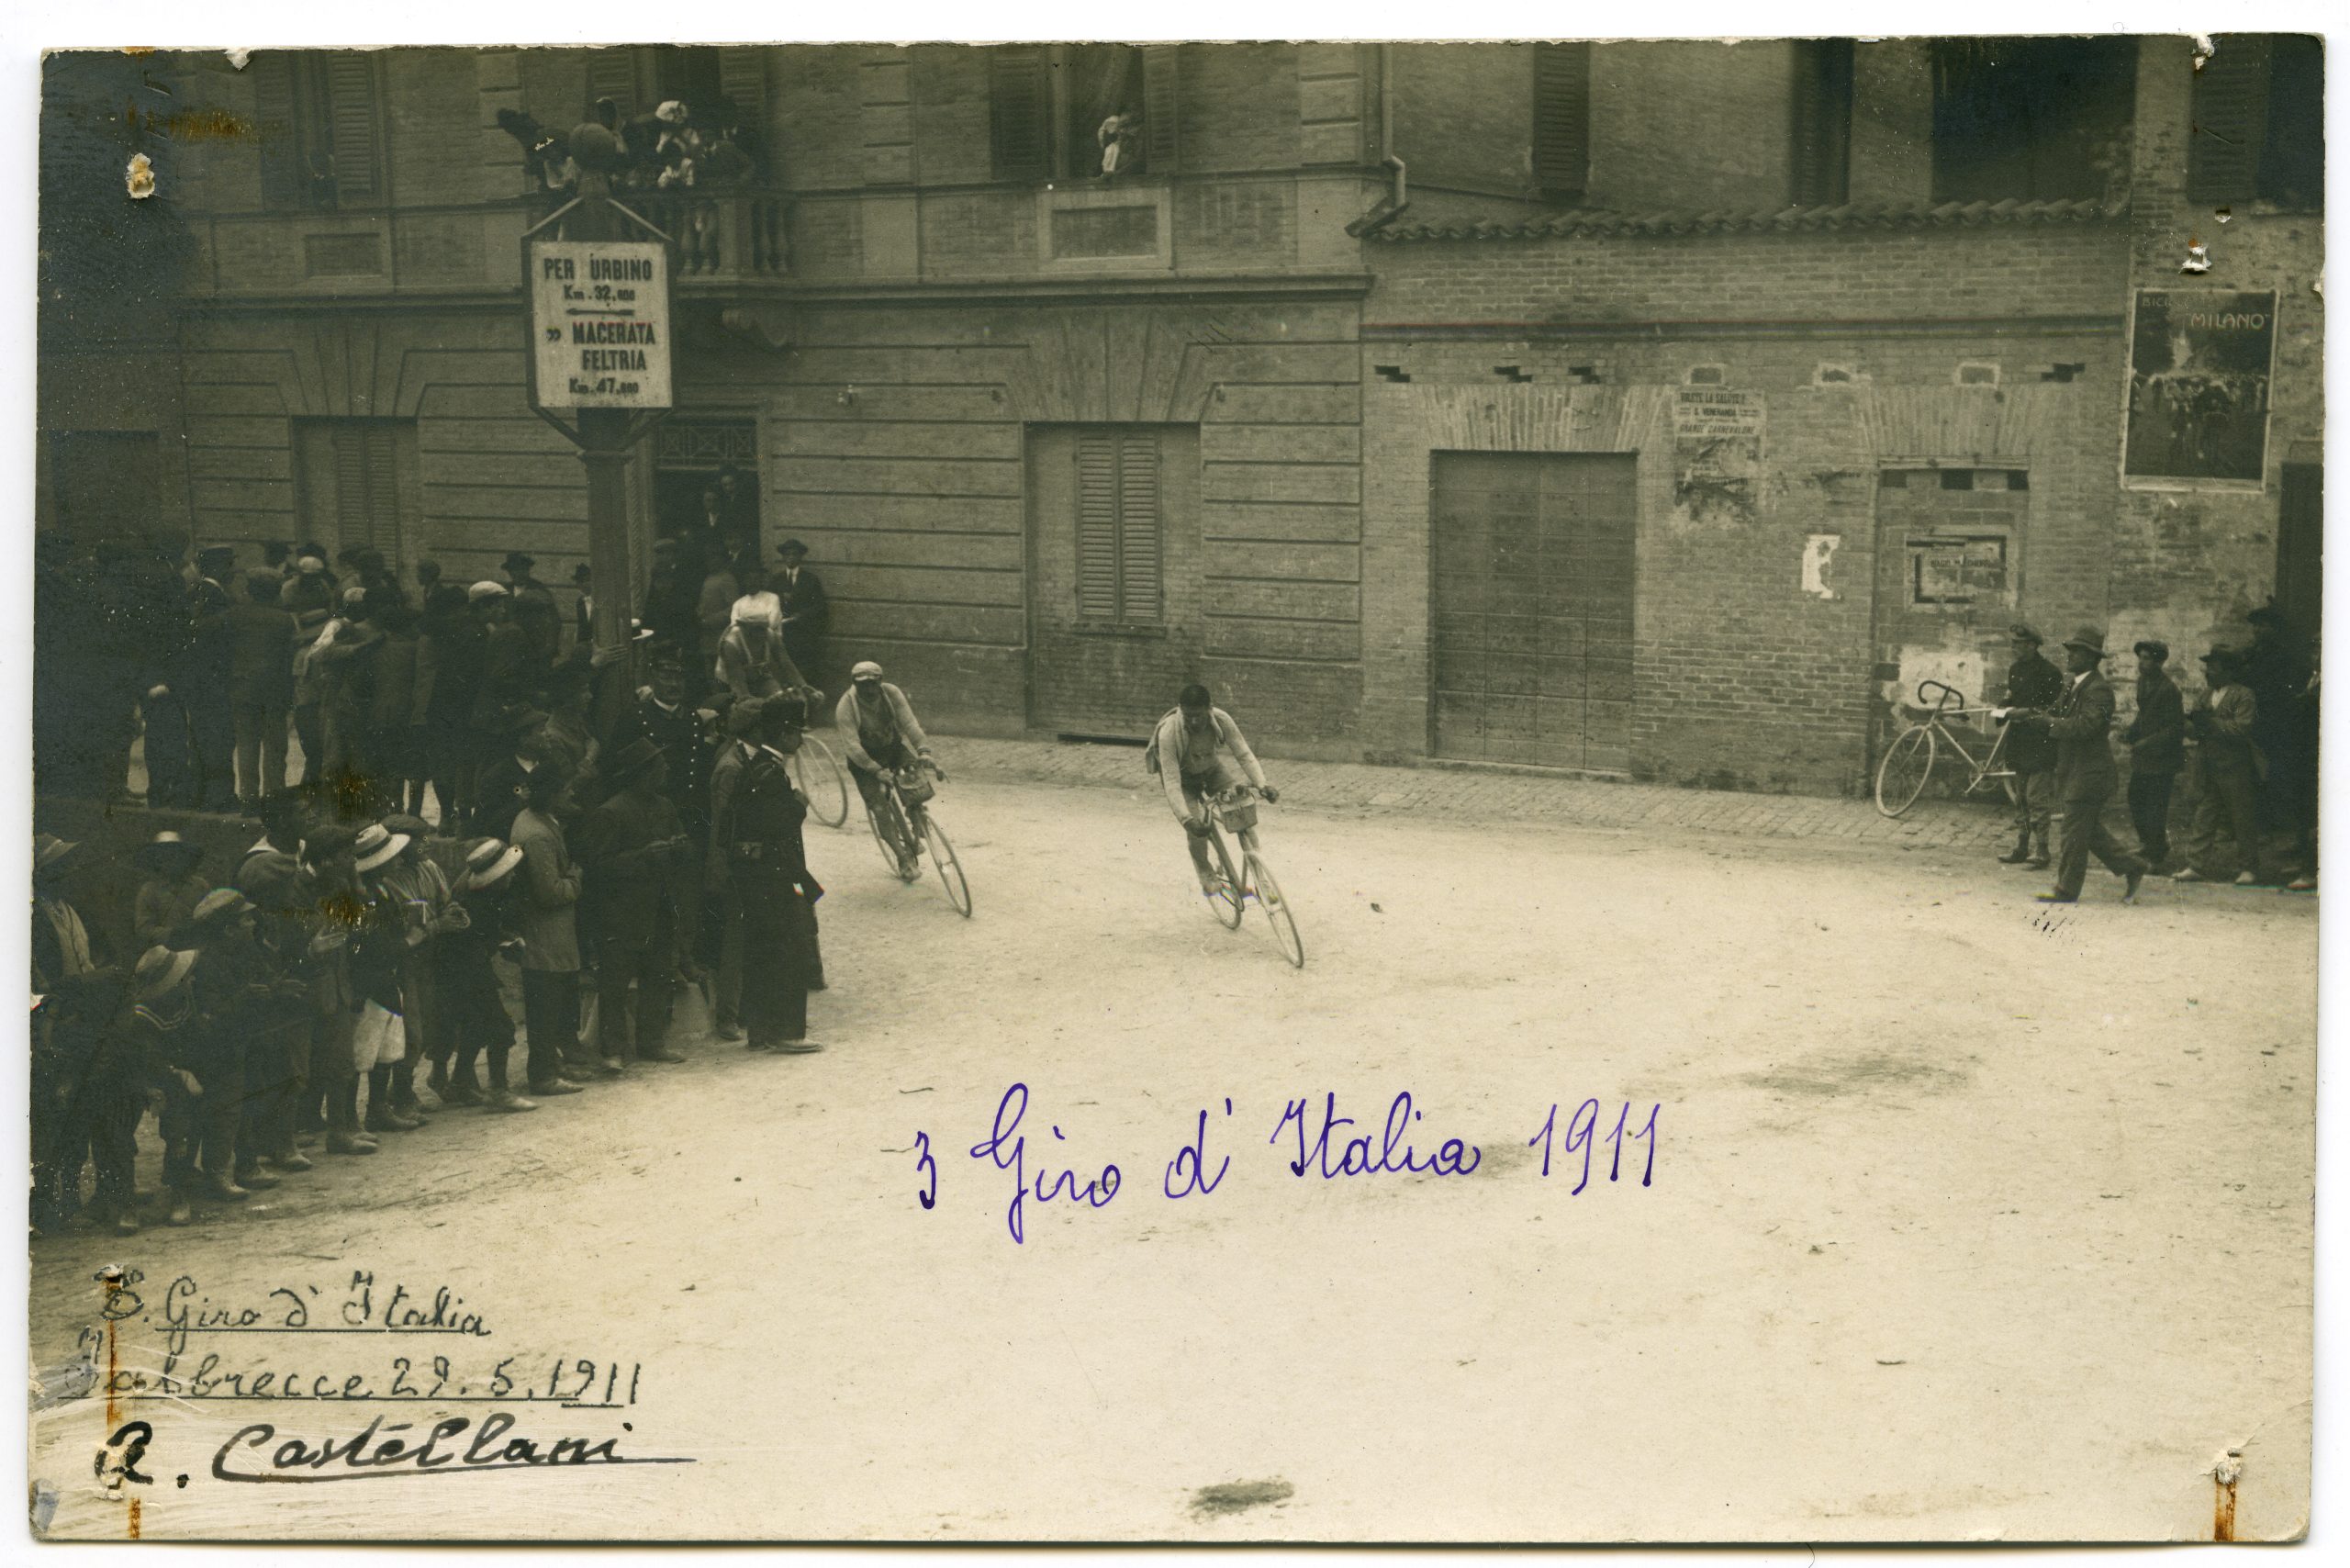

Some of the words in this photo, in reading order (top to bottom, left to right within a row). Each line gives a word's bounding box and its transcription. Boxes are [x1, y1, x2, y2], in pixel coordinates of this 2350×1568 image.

[543, 258, 575, 280] PER
[590, 258, 653, 281] URBINO
[573, 322, 655, 345] MACERATA
[582, 349, 646, 371] FELTRIA
[1680, 423, 1706, 434] GRANDE
[1707, 424, 1755, 434] CARNEVALONE
[915, 1132, 936, 1209] 3
[970, 1083, 1121, 1245] Giro
[1270, 1092, 1481, 1179] Italia
[1529, 1099, 1660, 1195] 1911
[166, 1275, 262, 1357] Giro
[342, 1270, 493, 1336] Italia
[211, 1414, 647, 1484] Castellani
